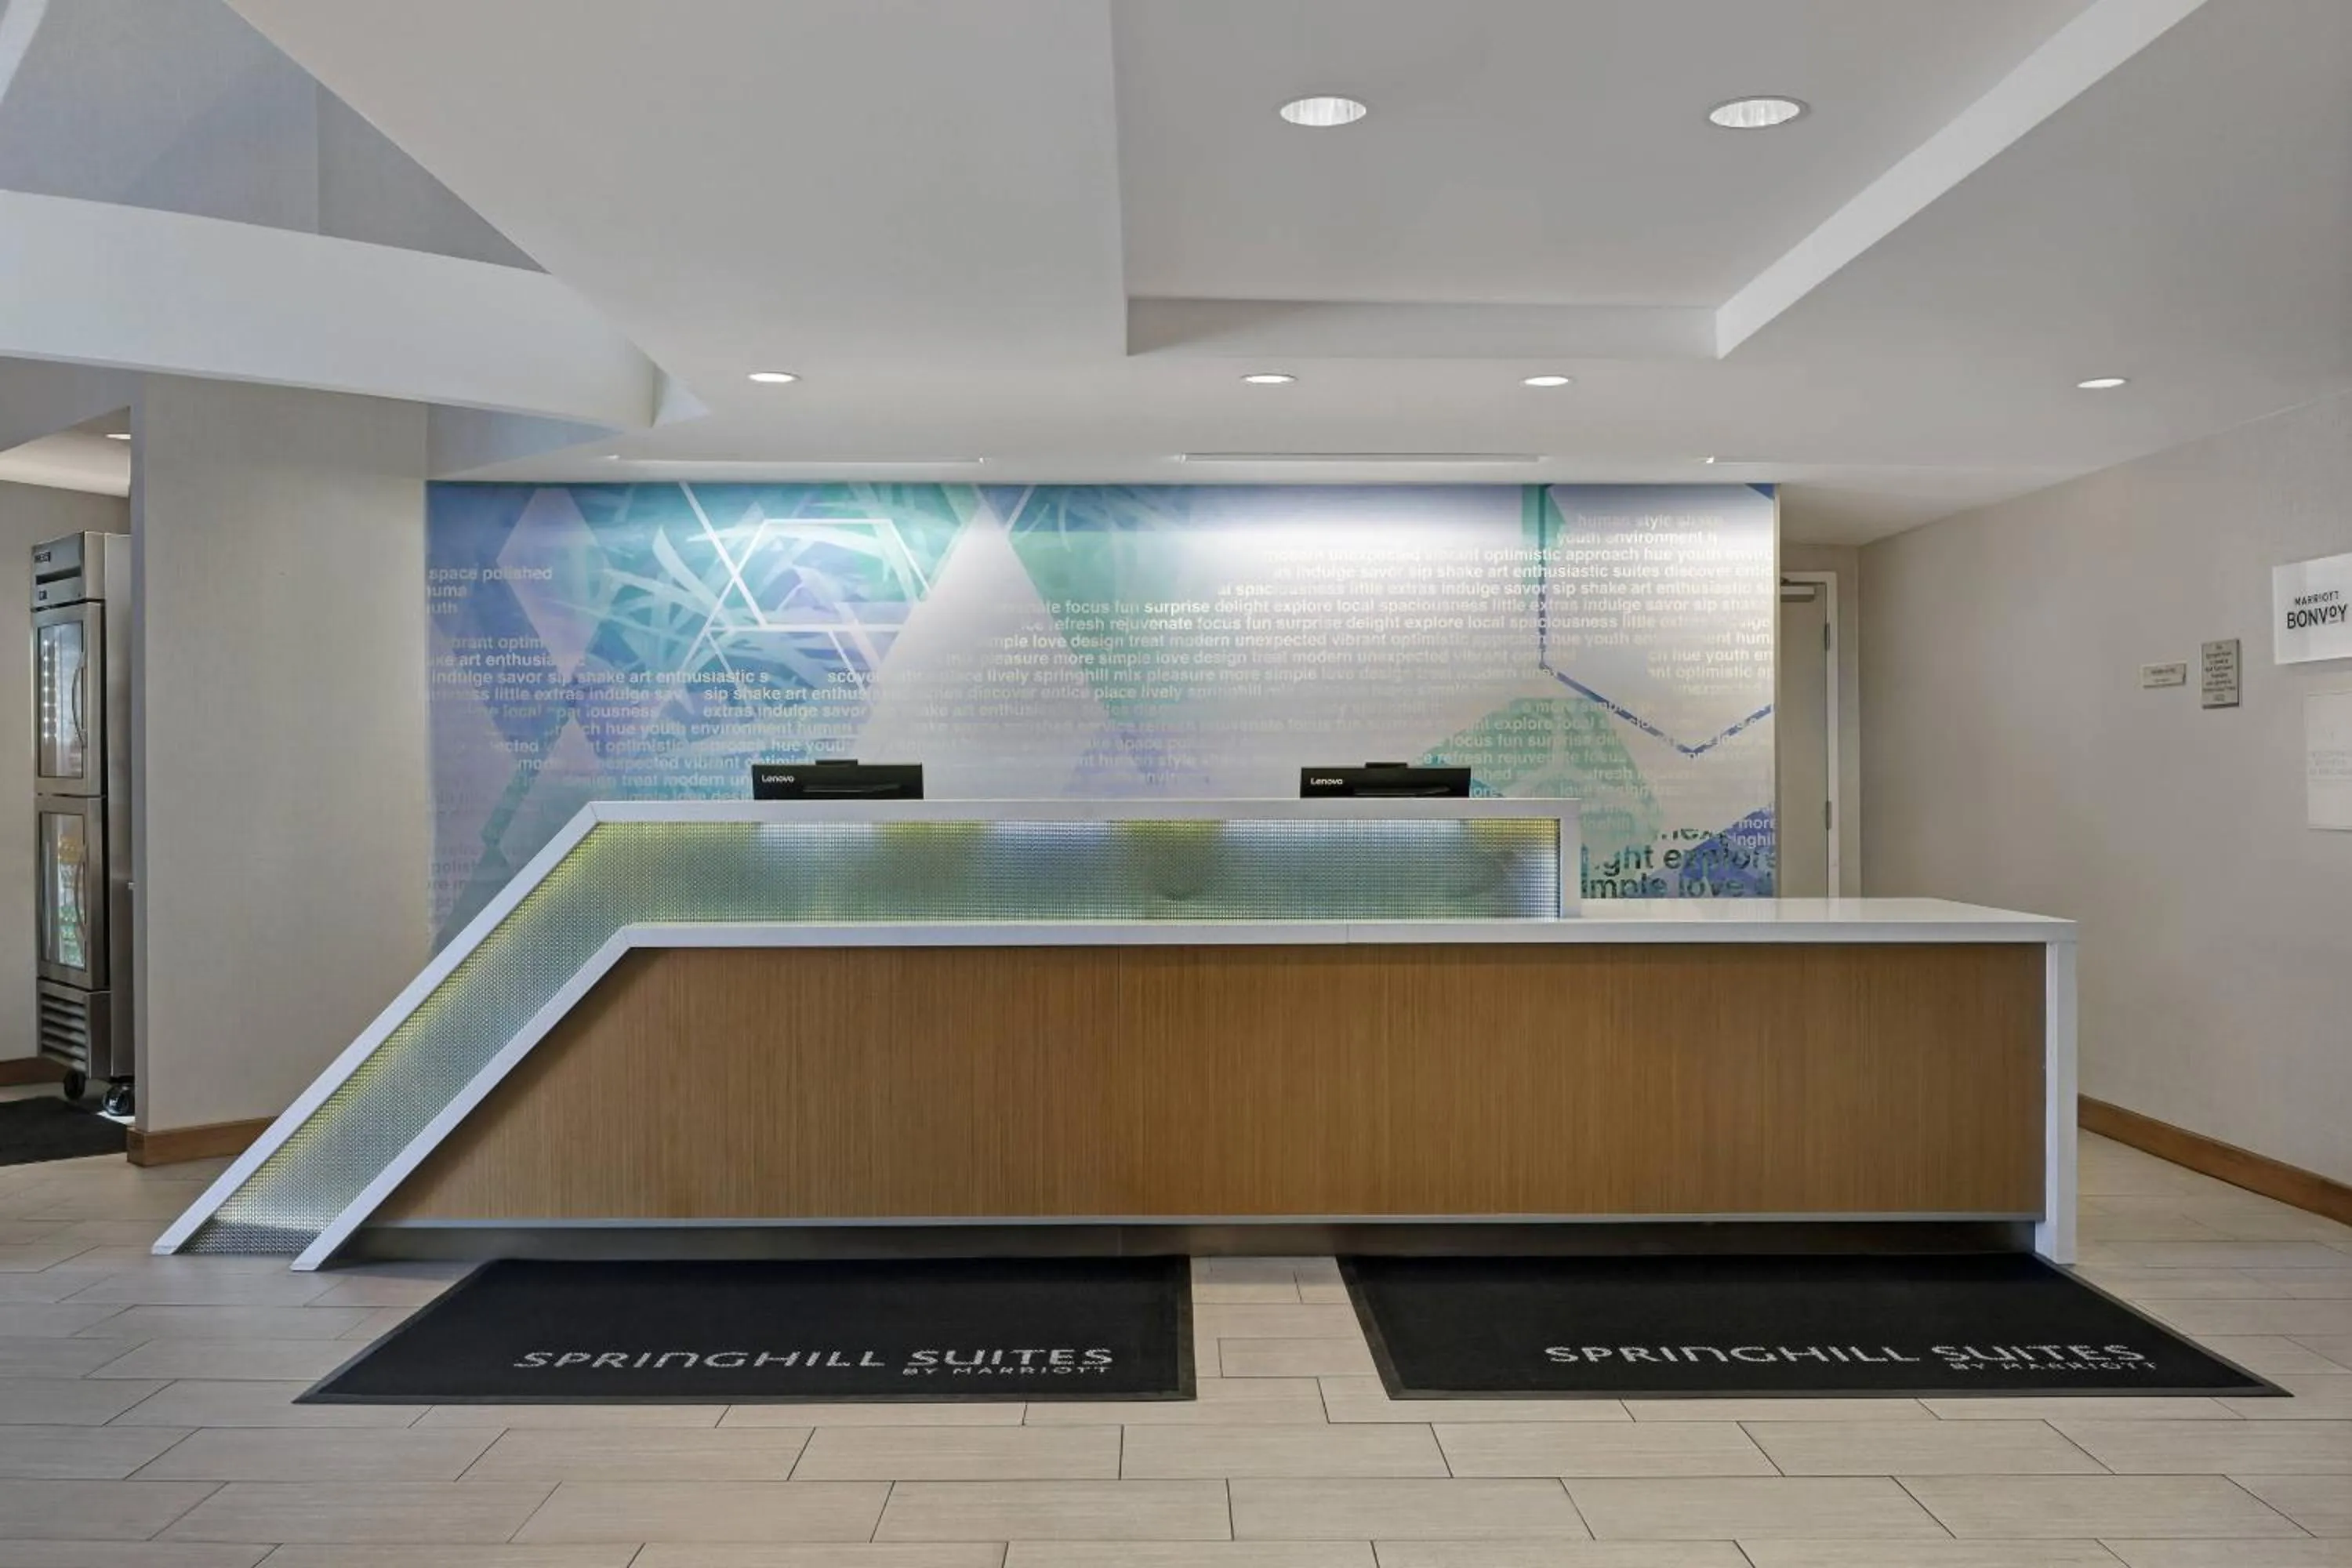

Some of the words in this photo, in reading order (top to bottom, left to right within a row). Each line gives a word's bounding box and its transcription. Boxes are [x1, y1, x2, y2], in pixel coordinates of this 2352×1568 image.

[1556, 531, 1600, 547] youth
[1484, 546, 1561, 564] optimistic
[1565, 546, 1639, 564] approach
[1643, 546, 1671, 561] hue
[1676, 546, 1721, 564] youth
[428, 566, 477, 583] space
[483, 566, 554, 584] polished
[1297, 564, 1355, 583] indulge
[1360, 566, 1403, 579] savor
[1410, 564, 1432, 582] sip
[1437, 564, 1483, 579] shake
[1488, 564, 1508, 578] art
[1512, 562, 1608, 578] enthusiastic
[1612, 562, 1660, 577] suites
[1664, 562, 1730, 577] discover
[1387, 581, 1437, 595] extras
[1442, 580, 1500, 598] indulge
[1504, 583, 1547, 595] savor
[1552, 580, 1576, 597] sip
[1580, 579, 1627, 594] shake
[1631, 579, 1652, 594] art
[1656, 579, 1751, 594] enthusiastic
[2295, 590, 2339, 606] MARRIOTT
[1065, 599, 1109, 614] focus
[1115, 599, 1139, 614] fun
[1144, 600, 1210, 617] surprise
[1214, 599, 1269, 617] delight
[1273, 598, 1332, 617] explore
[1337, 597, 1374, 612] local
[1378, 597, 1488, 615] spaciousness
[1492, 597, 1525, 612] little
[1584, 596, 1642, 615] indulge
[1646, 599, 1689, 612] savor
[1693, 596, 1717, 614] sip
[1109, 617, 1192, 634] rejuvenate
[1197, 617, 1241, 630] focus
[1246, 616, 1272, 630] fun
[1276, 616, 1342, 633] surprise
[1346, 615, 1399, 633] delight
[1404, 615, 1464, 632] explore
[1468, 614, 1505, 629] local
[1509, 614, 1618, 632] spaciousness
[2287, 603, 2348, 630] BONVOY
[1033, 633, 1066, 648] love
[1070, 633, 1124, 652] design
[1129, 633, 1165, 648] treat
[1170, 633, 1230, 648] modern
[1235, 633, 1327, 651] unexpected
[1331, 631, 1386, 646] vibrant
[1391, 631, 1469, 649] optimistic
[1552, 630, 1581, 645] hue
[1584, 630, 1631, 648] youth
[459, 652, 481, 667] art
[1054, 653, 1094, 666] more
[1099, 652, 1151, 669] simple
[1156, 651, 1190, 665] love
[1194, 650, 1247, 668] design
[1292, 650, 1352, 665] modern
[1357, 649, 1449, 667] unexpected
[1672, 647, 1701, 662] hue
[1705, 647, 1750, 665] youth
[432, 672, 492, 688] indulge
[497, 673, 543, 685] savor
[579, 670, 626, 684] shake
[630, 670, 652, 684] art
[656, 669, 755, 684] enthusiastic
[988, 667, 1029, 686] lively
[1033, 667, 1109, 687] springhill
[1113, 668, 1142, 682] mix
[1146, 668, 1216, 686] pleasure
[1220, 669, 1260, 682] more
[1264, 666, 1316, 685] simple
[1675, 664, 1753, 682] optimistic
[494, 687, 530, 701] little
[534, 688, 585, 701] extras
[590, 687, 651, 705] indulge
[704, 687, 729, 705] sip
[734, 686, 782, 701] shake
[786, 687, 808, 701] art
[1094, 684, 1138, 703] place
[1142, 684, 1183, 703] lively
[702, 704, 753, 717] extras
[757, 702, 818, 720] indulge
[606, 720, 637, 735] hue
[1493, 714, 1552, 734] explore
[1498, 731, 1523, 748] fun
[1497, 749, 1579, 768] rejuvente
[761, 774, 795, 783] Lenovo
[1310, 777, 1344, 786] Lenovo
[514, 1351, 885, 1368] SPRINGHILL
[907, 1348, 1113, 1367] SUITES
[1544, 1345, 1920, 1363] SPRINGHILL
[1931, 1344, 2144, 1362] SUITES
[902, 1367, 938, 1377] BY
[952, 1366, 1112, 1376] MARRIOTT
